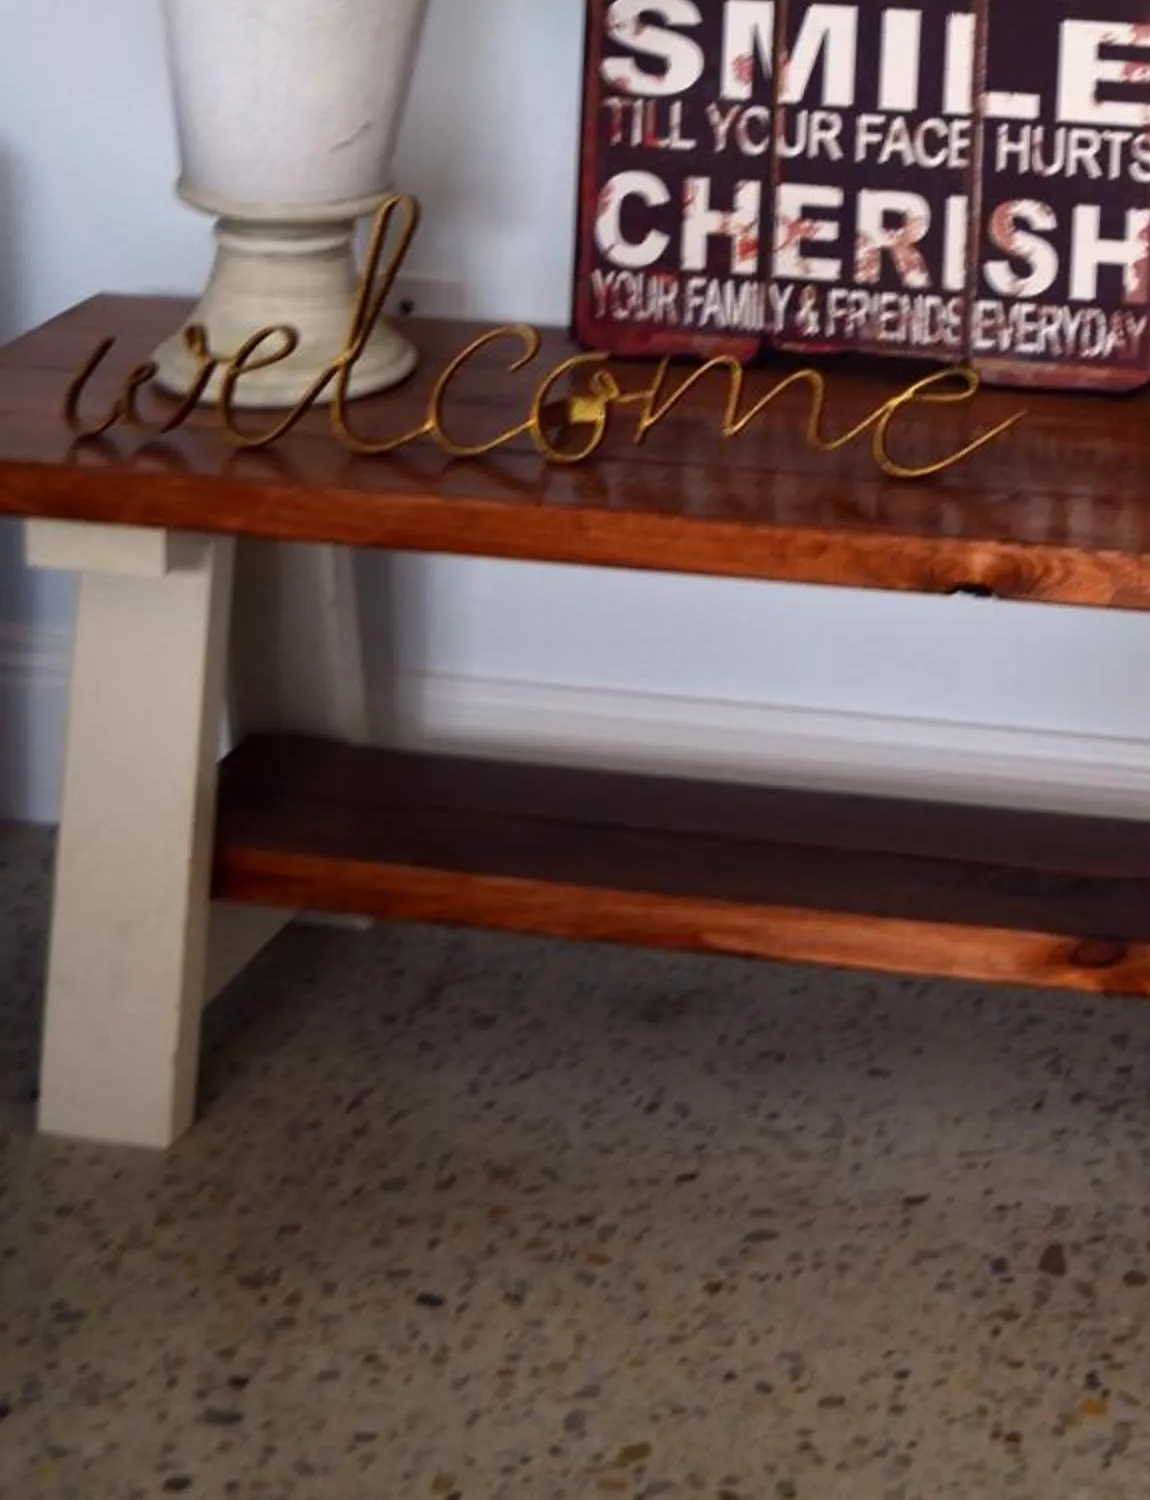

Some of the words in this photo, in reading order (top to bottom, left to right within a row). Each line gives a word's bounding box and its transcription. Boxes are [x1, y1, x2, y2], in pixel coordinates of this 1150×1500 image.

[604, 97, 697, 150] TILL
[705, 103, 844, 161] YOUR
[853, 113, 974, 169] FACE
[62, 194, 1030, 480] welcome
[591, 268, 679, 324] YOUR
[682, 277, 794, 334] FAMILY
[796, 284, 820, 337] &
[824, 288, 964, 345] FRIENDS
[968, 299, 1148, 358] EVERYDAY
